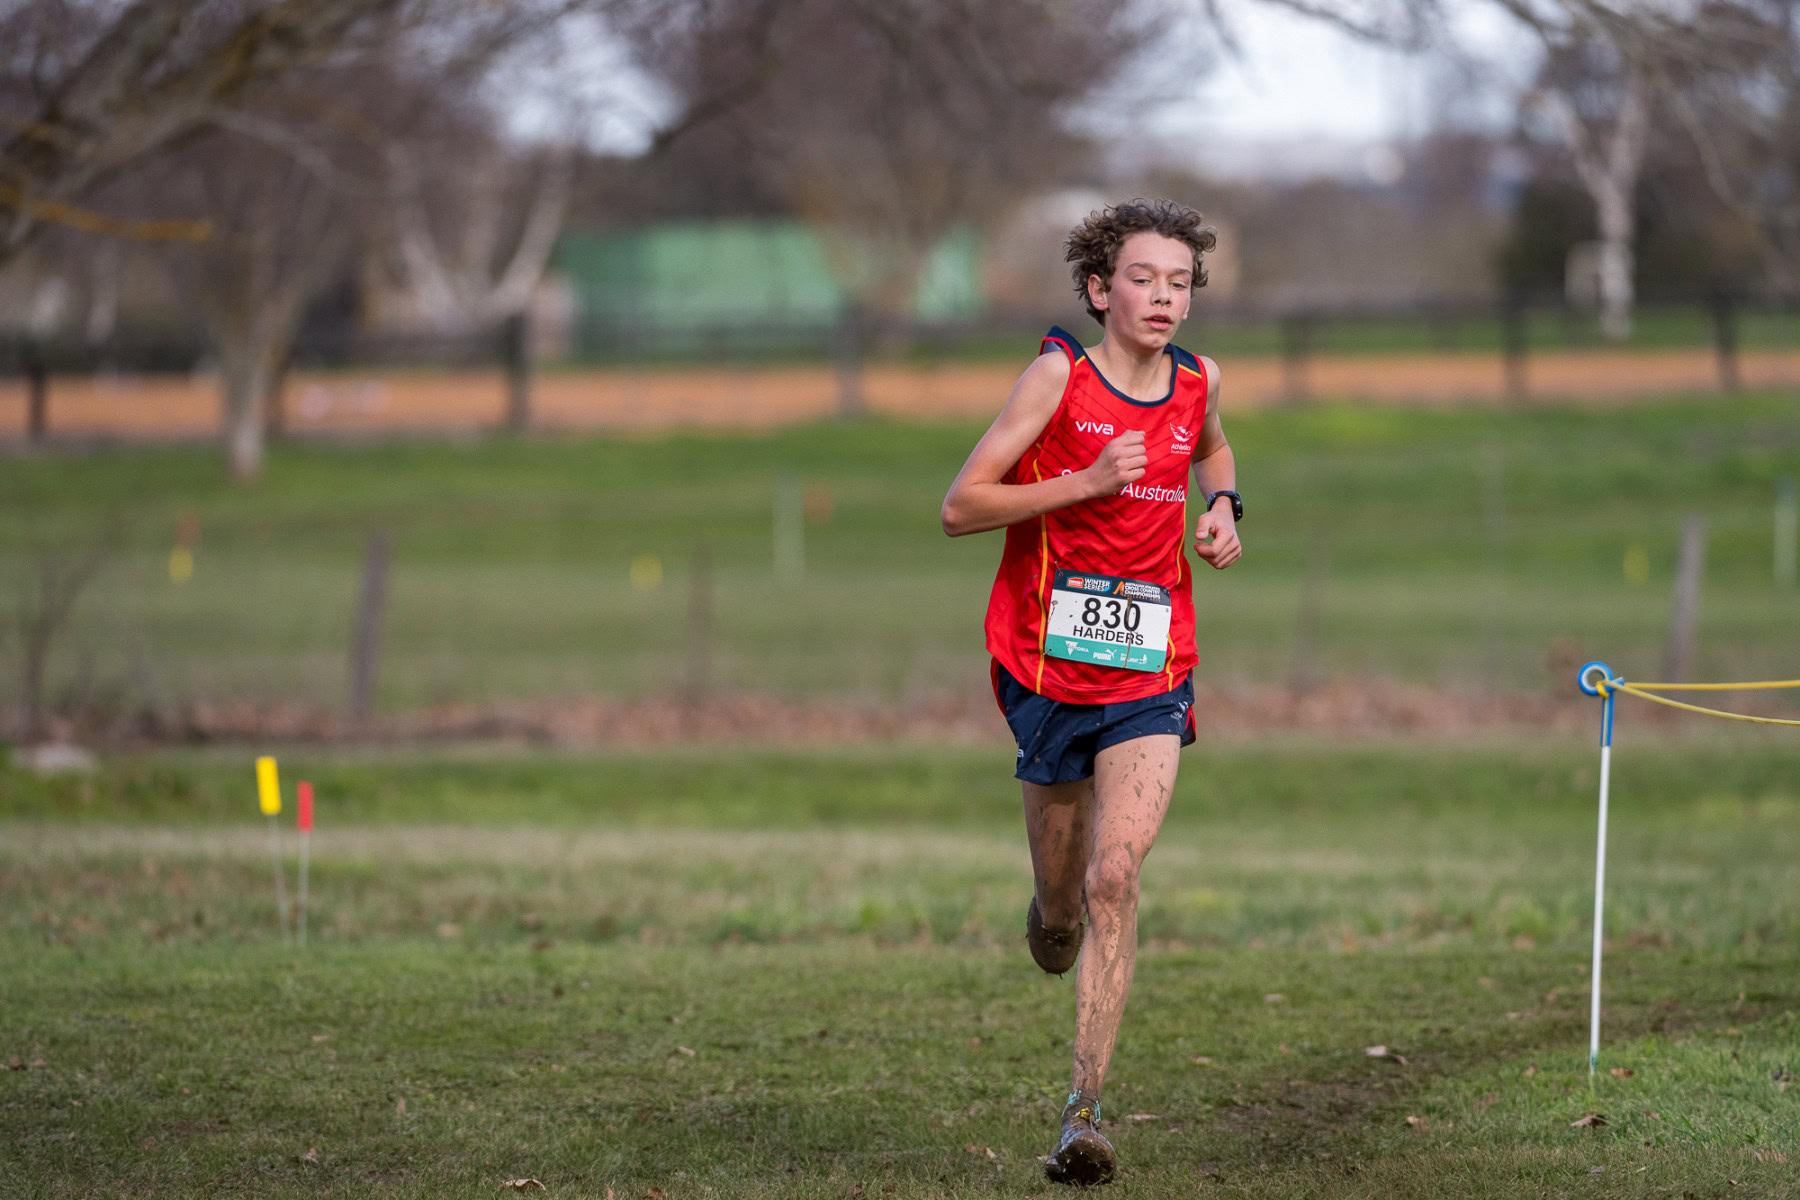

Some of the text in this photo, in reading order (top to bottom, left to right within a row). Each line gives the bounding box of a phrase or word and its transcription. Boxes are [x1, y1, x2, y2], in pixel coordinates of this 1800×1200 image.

[1120, 482, 1186, 502] Australia
[1084, 578, 1110, 587] WINTER
[1082, 597, 1141, 632] 830
[1073, 625, 1144, 646] HARDERS
[1093, 652, 1112, 661] PUMA
